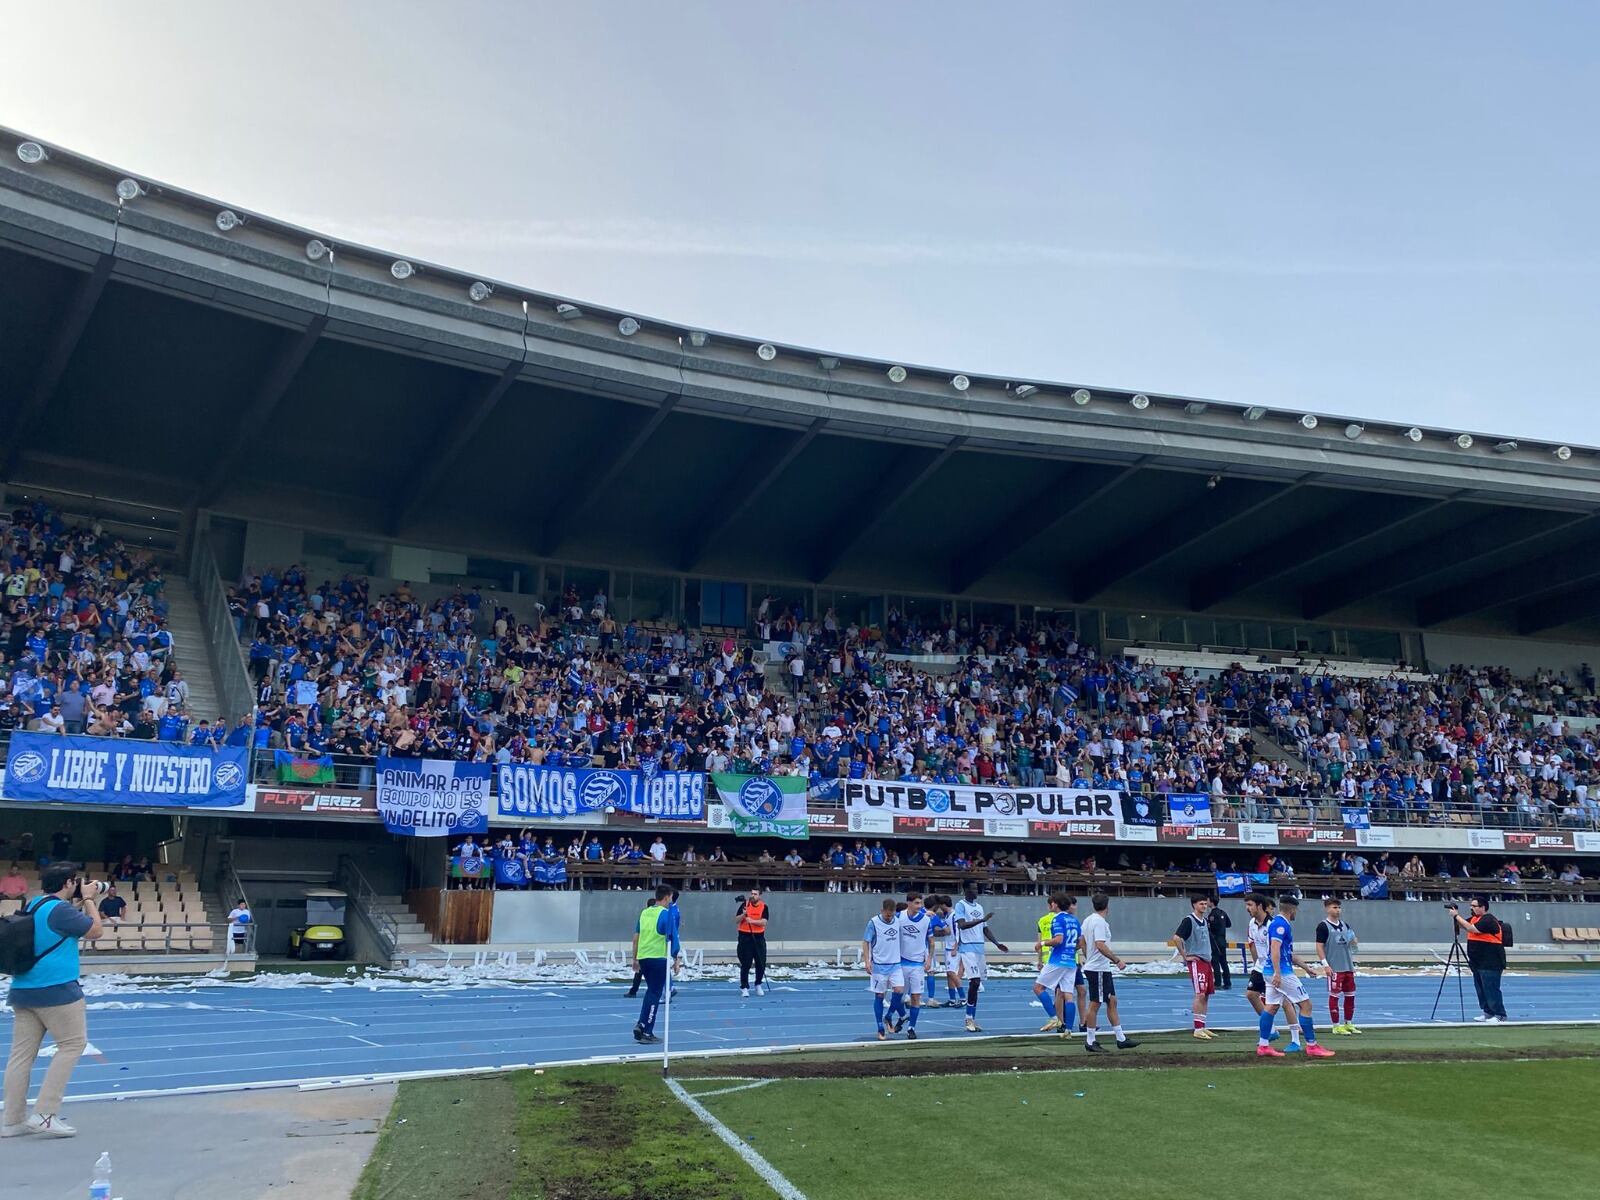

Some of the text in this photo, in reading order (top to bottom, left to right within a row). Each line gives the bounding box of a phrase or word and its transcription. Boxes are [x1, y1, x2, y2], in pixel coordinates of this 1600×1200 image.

[47, 748, 212, 794] LIBRE Y NUESTRO
[384, 769, 482, 791] ANIMAR A TU
[380, 788, 482, 809] EQUIPO NO ES
[500, 765, 703, 815] SOMOS LIBRES
[263, 792, 363, 812] PLAY JEREZ
[401, 809, 457, 828] DELITO
[899, 817, 933, 827] PLAY
[926, 818, 970, 831] JEREZ
[1034, 822, 1064, 832] PLAY
[1059, 823, 1101, 836] JEREZ
[1162, 826, 1192, 836] PLAY
[1187, 826, 1226, 840] JEREZ
[1283, 830, 1311, 838] PLAY
[1306, 828, 1344, 842] JEREZ
[1508, 835, 1533, 844] PLAY
[1529, 836, 1564, 848] JEREZ
[1066, 928, 1078, 948] 22
[1197, 973, 1206, 982] 23
